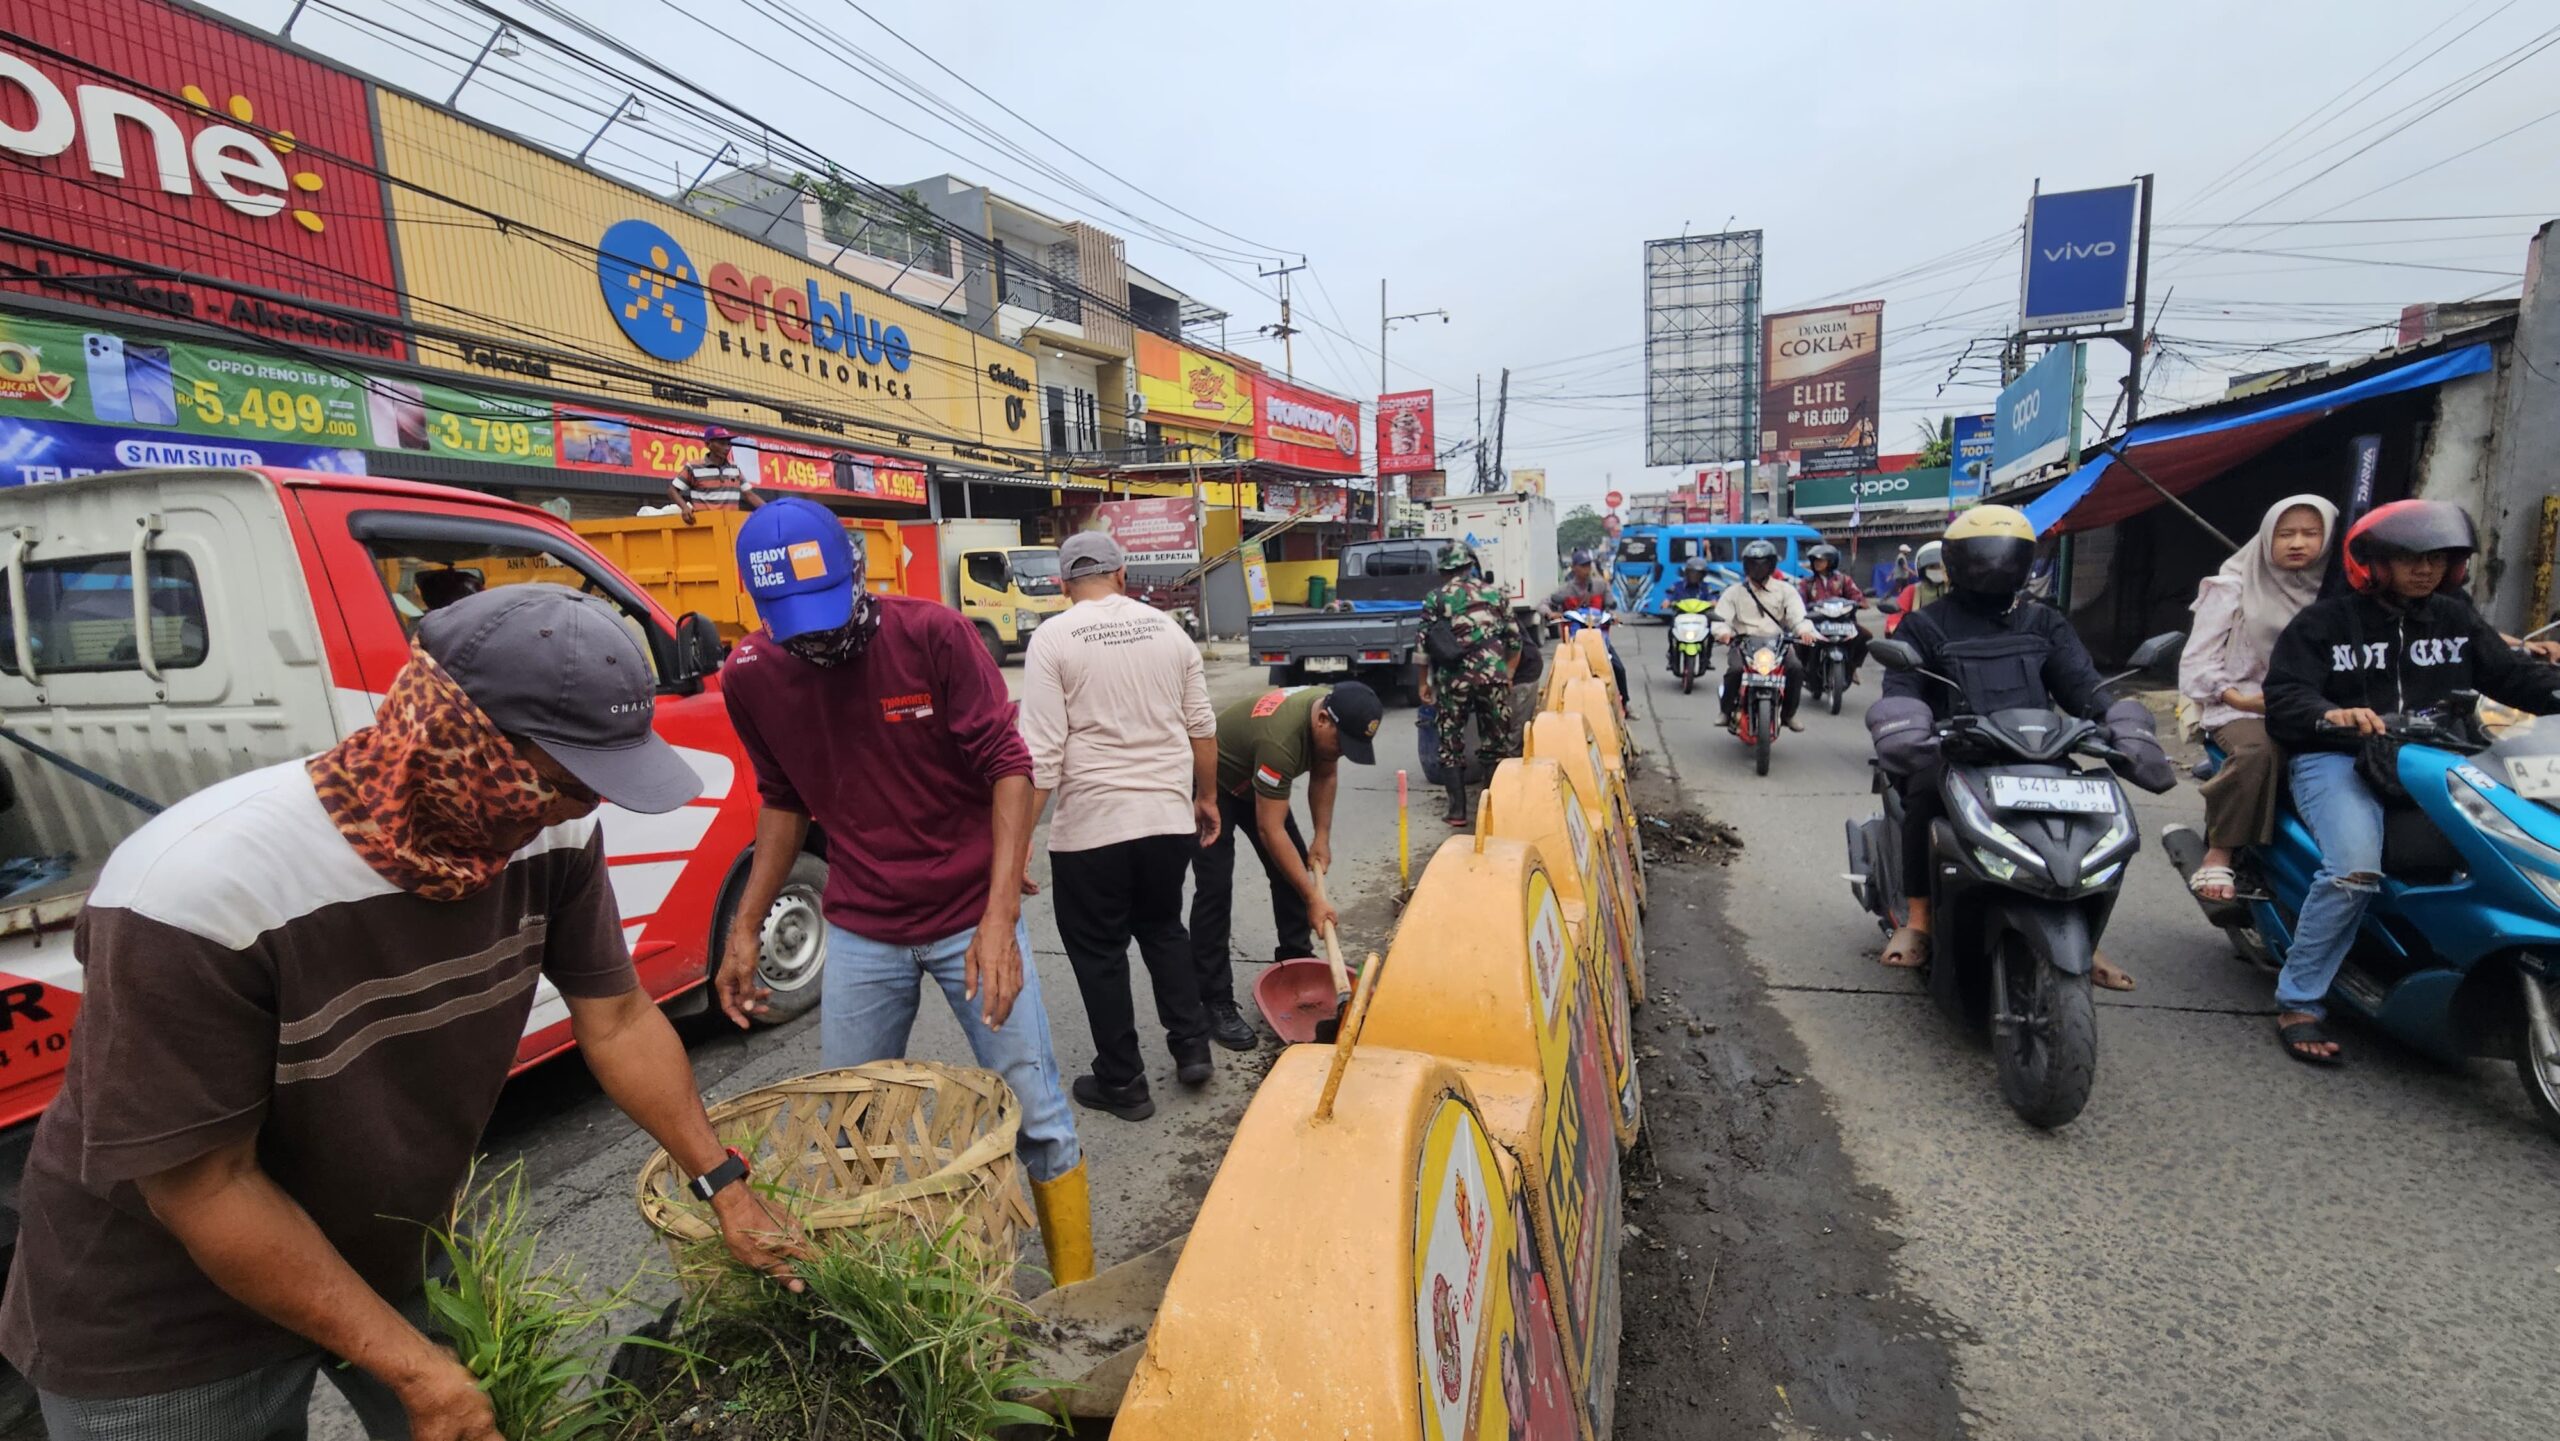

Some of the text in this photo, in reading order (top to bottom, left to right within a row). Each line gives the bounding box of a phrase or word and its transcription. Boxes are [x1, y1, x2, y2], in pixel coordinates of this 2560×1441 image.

[2043, 241, 2117, 262] vivo
[709, 262, 912, 373] erablue
[1854, 301, 1882, 314] BARU
[1779, 332, 1867, 357] COKLAT
[207, 358, 255, 377] OPPO
[257, 362, 301, 384] RENO
[300, 371, 316, 384] 15
[320, 374, 328, 387] F
[718, 330, 912, 400] ELECTRONICS
[1793, 380, 1846, 406] ELITE
[193, 379, 325, 435] 5.499
[1803, 406, 1850, 428] 18.000
[2012, 387, 2041, 437] oppo
[440, 412, 530, 457] 3.799
[126, 445, 255, 468] SAMSUNG
[1850, 477, 1910, 497] oppo
[750, 547, 787, 564] READY
[1155, 552, 1193, 561] SEPATAN
[752, 564, 766, 576] TO
[754, 572, 786, 588] RACE
[2018, 777, 2061, 793] 6413
